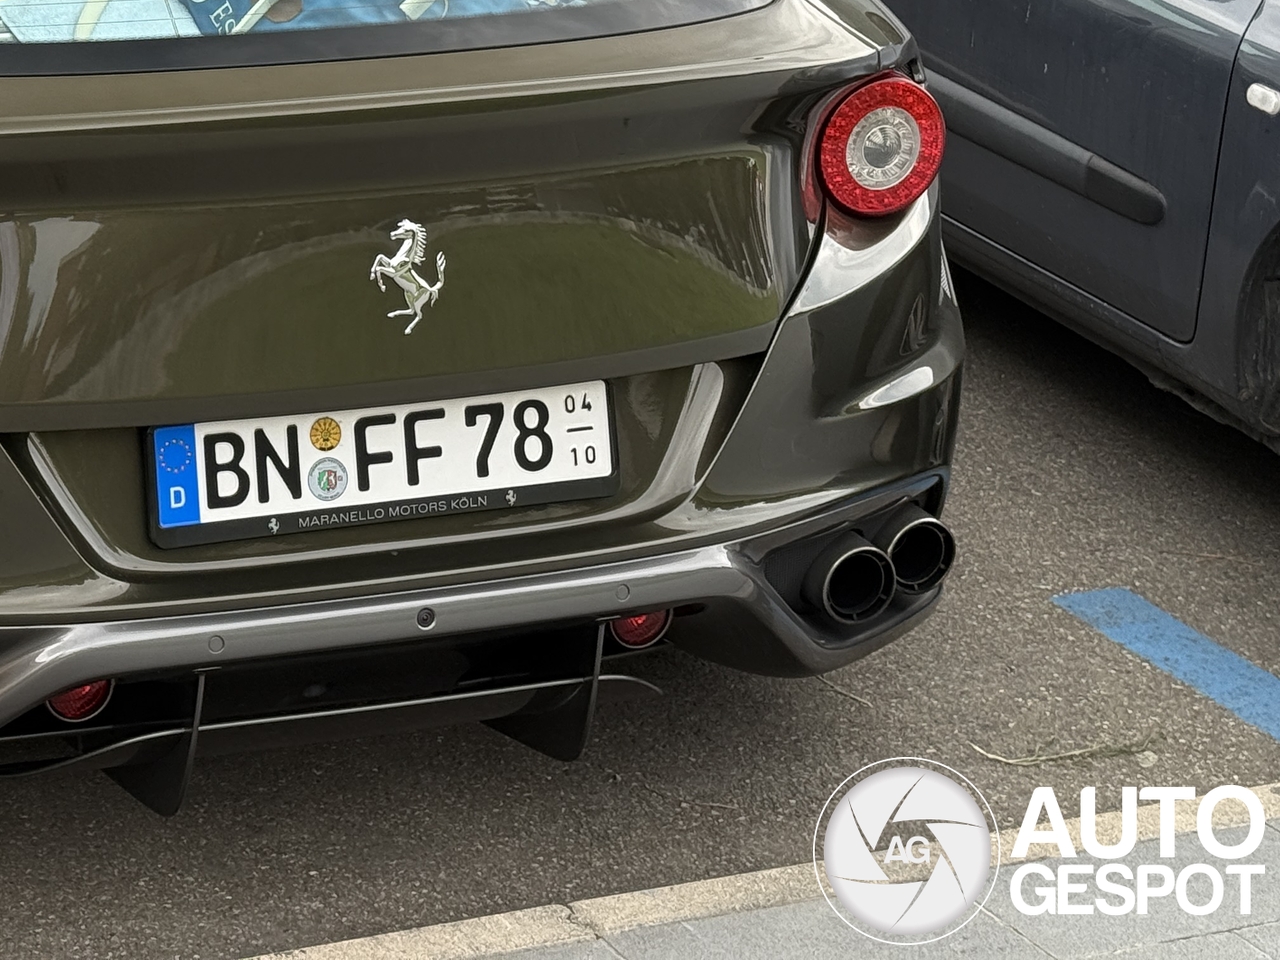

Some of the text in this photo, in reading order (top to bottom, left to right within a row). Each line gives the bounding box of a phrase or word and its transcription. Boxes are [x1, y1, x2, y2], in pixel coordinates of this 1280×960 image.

[565, 393, 592, 413] 04
[203, 424, 302, 510] BN
[353, 408, 446, 491] FF
[464, 399, 553, 478] 78
[570, 445, 596, 466] 10
[170, 486, 186, 509] D
[298, 495, 488, 528] MARANELLO MOTORS KÖLN
